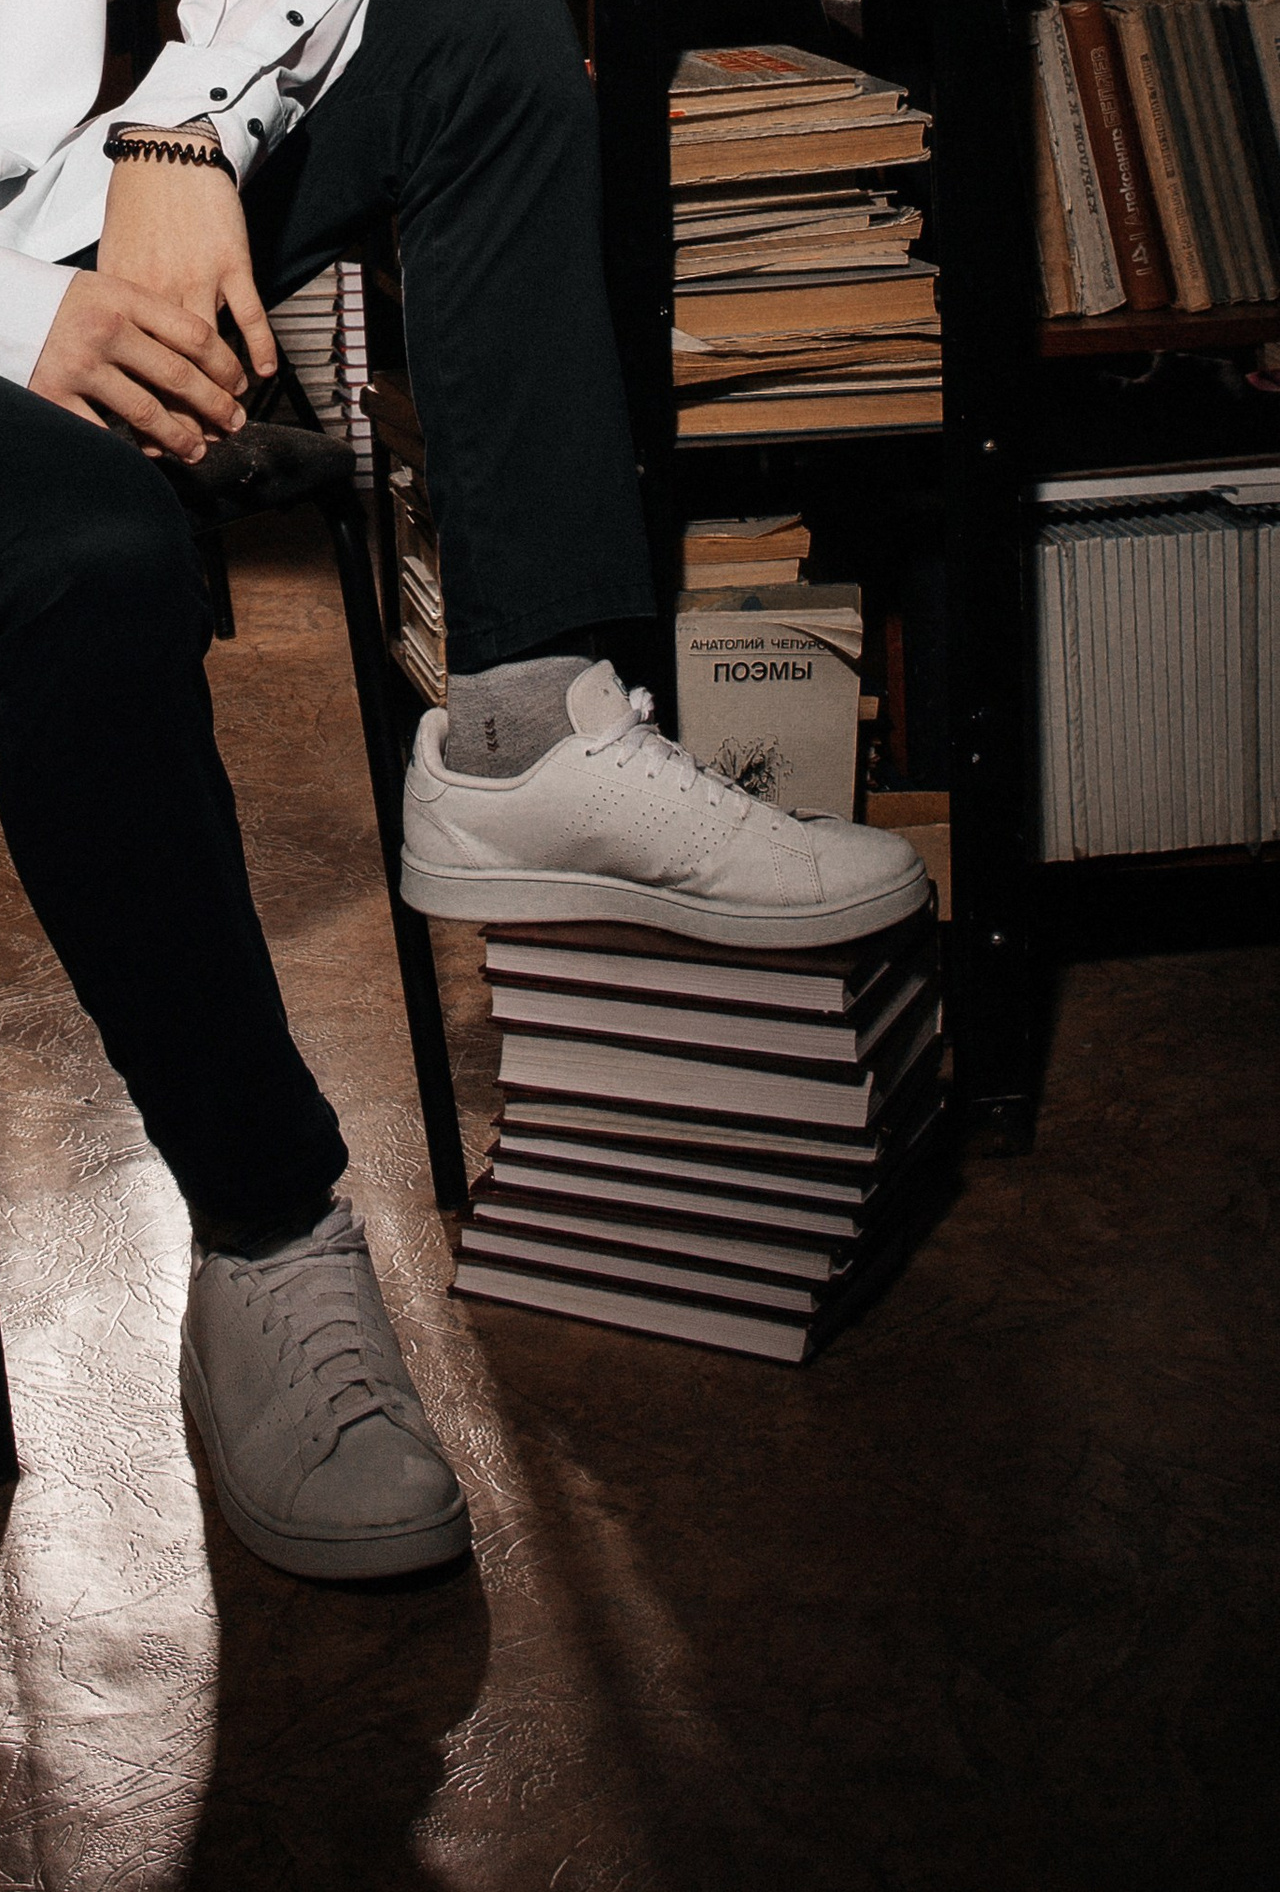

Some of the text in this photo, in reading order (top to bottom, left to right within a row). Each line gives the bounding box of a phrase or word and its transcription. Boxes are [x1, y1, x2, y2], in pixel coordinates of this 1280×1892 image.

[1090, 44, 1121, 129] БЕЛЯЕВ
[1073, 124, 1099, 216] КРЫЛОМ
[1110, 126, 1141, 227] Александр
[690, 636, 765, 651] АНАТОЛИЙ
[713, 661, 814, 683] ПОЭМЫ
